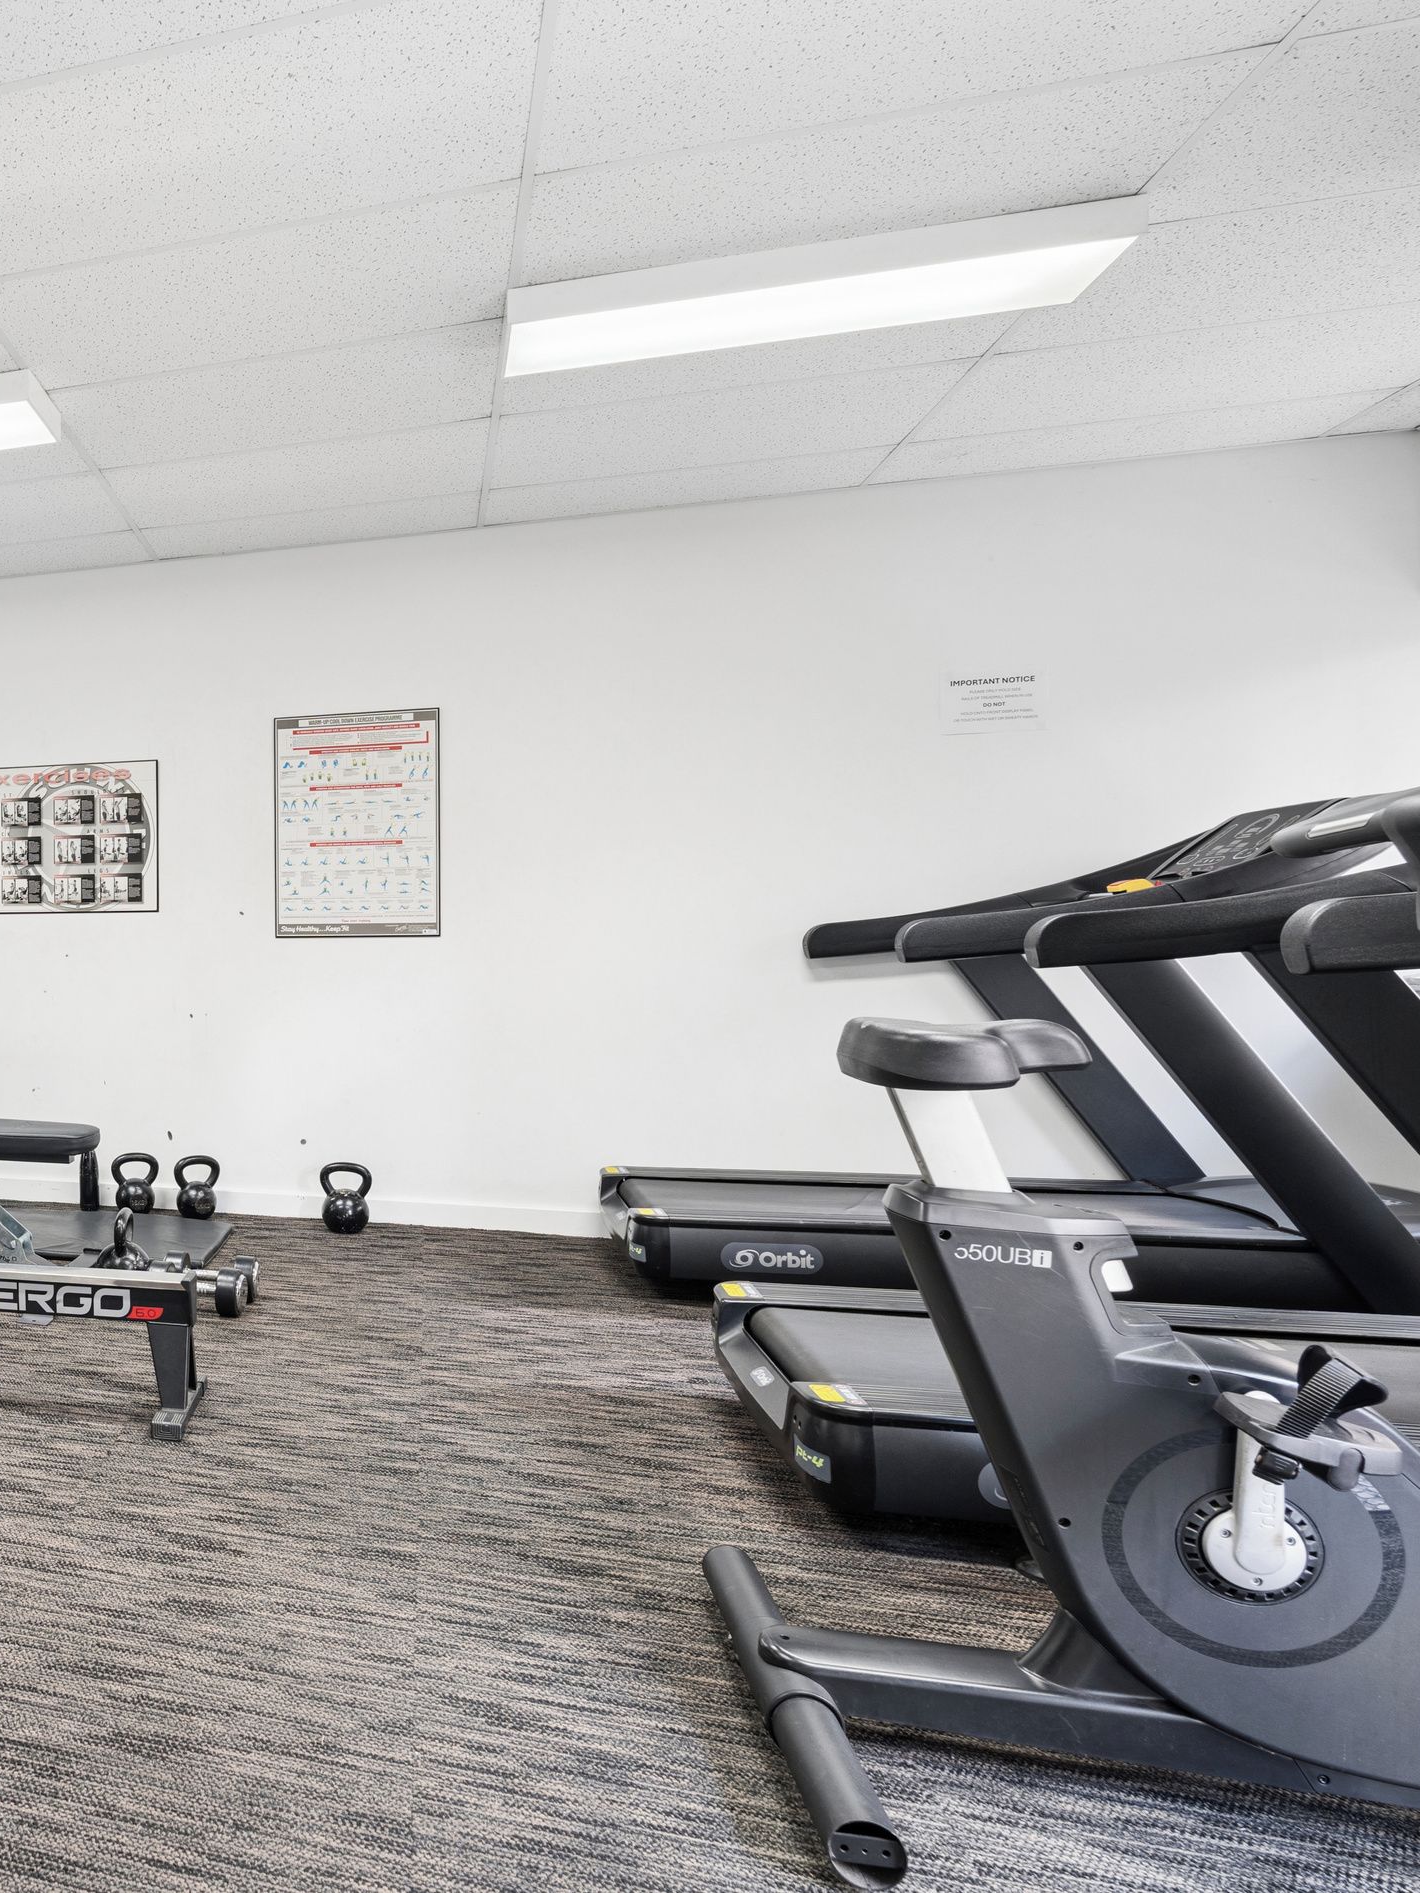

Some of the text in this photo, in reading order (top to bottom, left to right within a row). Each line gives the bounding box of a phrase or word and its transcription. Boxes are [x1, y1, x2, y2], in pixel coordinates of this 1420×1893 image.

[950, 678, 1000, 687] IMPORTANT
[281, 926, 295, 934] Stay
[759, 1250, 815, 1269] Orbit
